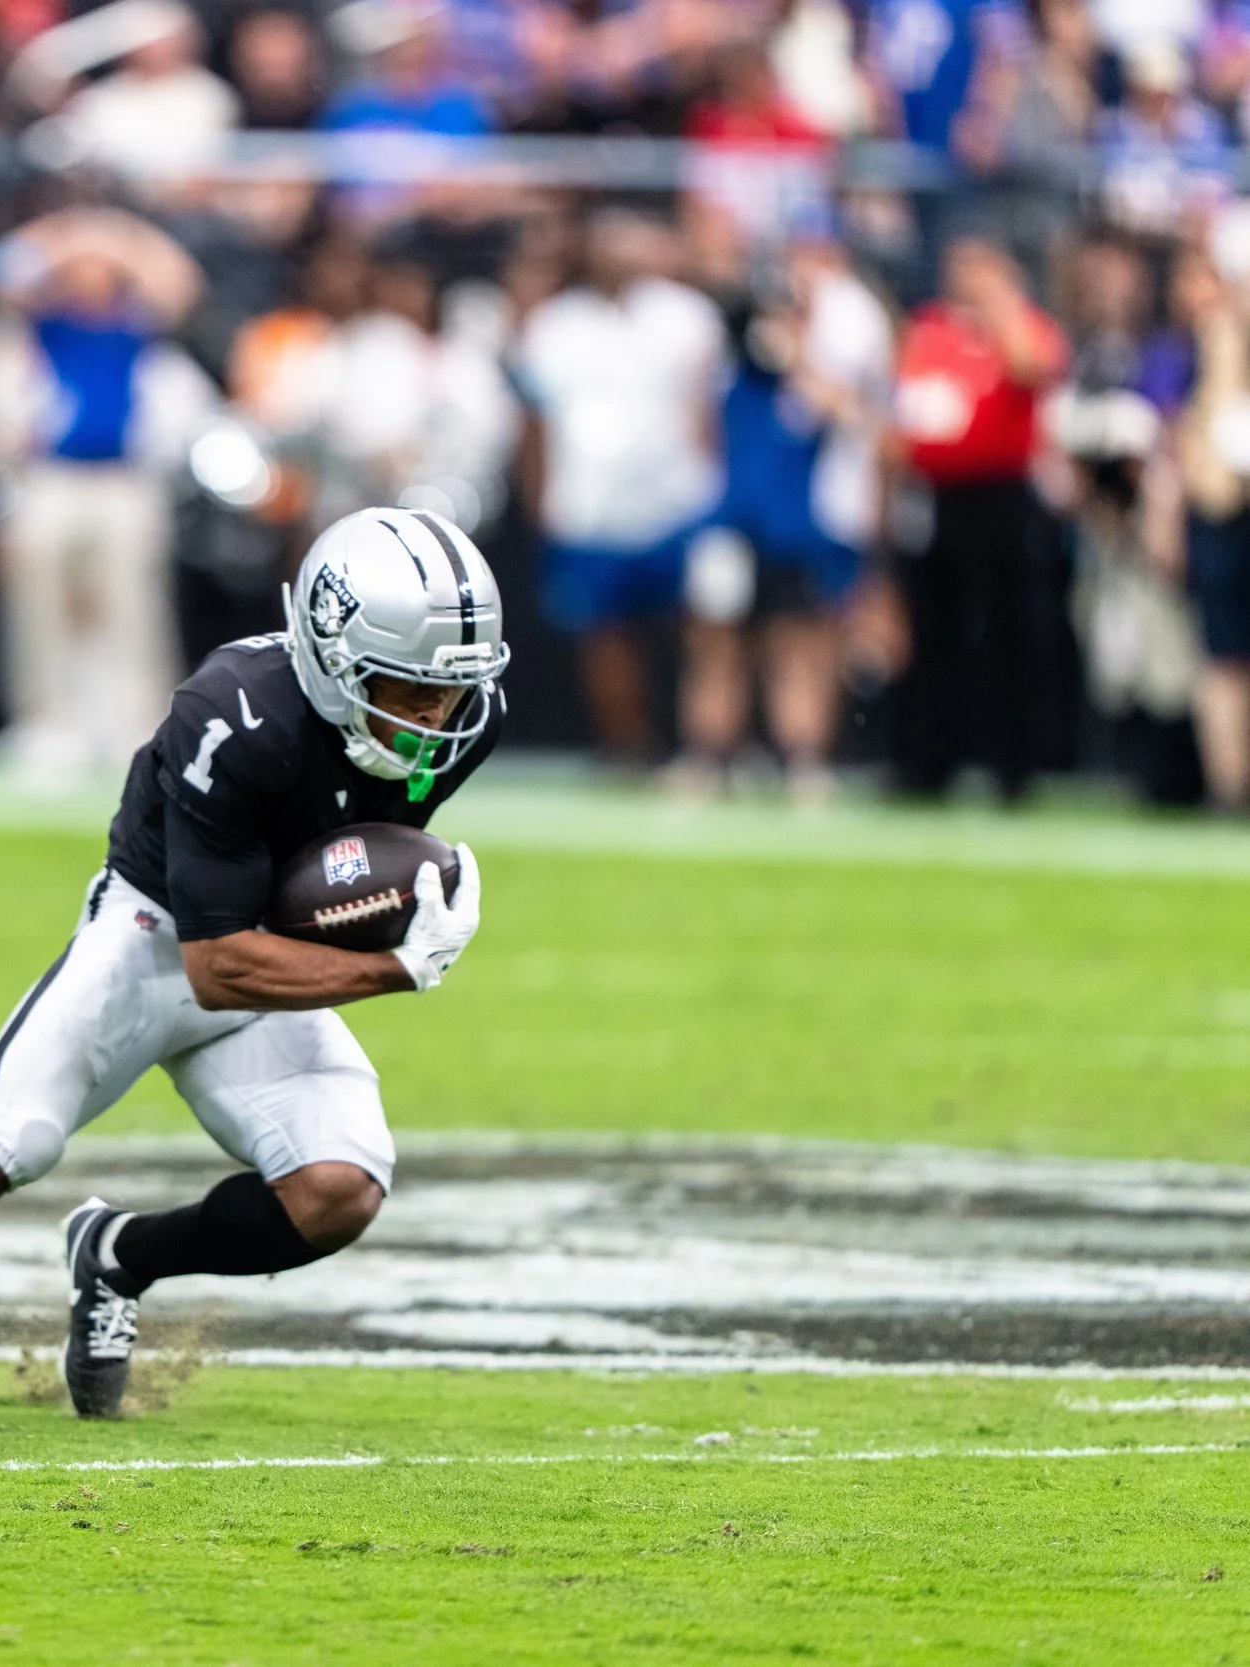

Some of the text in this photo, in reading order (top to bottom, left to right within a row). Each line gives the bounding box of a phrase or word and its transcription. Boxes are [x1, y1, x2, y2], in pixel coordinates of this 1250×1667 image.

[321, 567, 356, 608] RAIDERS
[182, 718, 234, 794] 1
[327, 840, 361, 863] NFL
